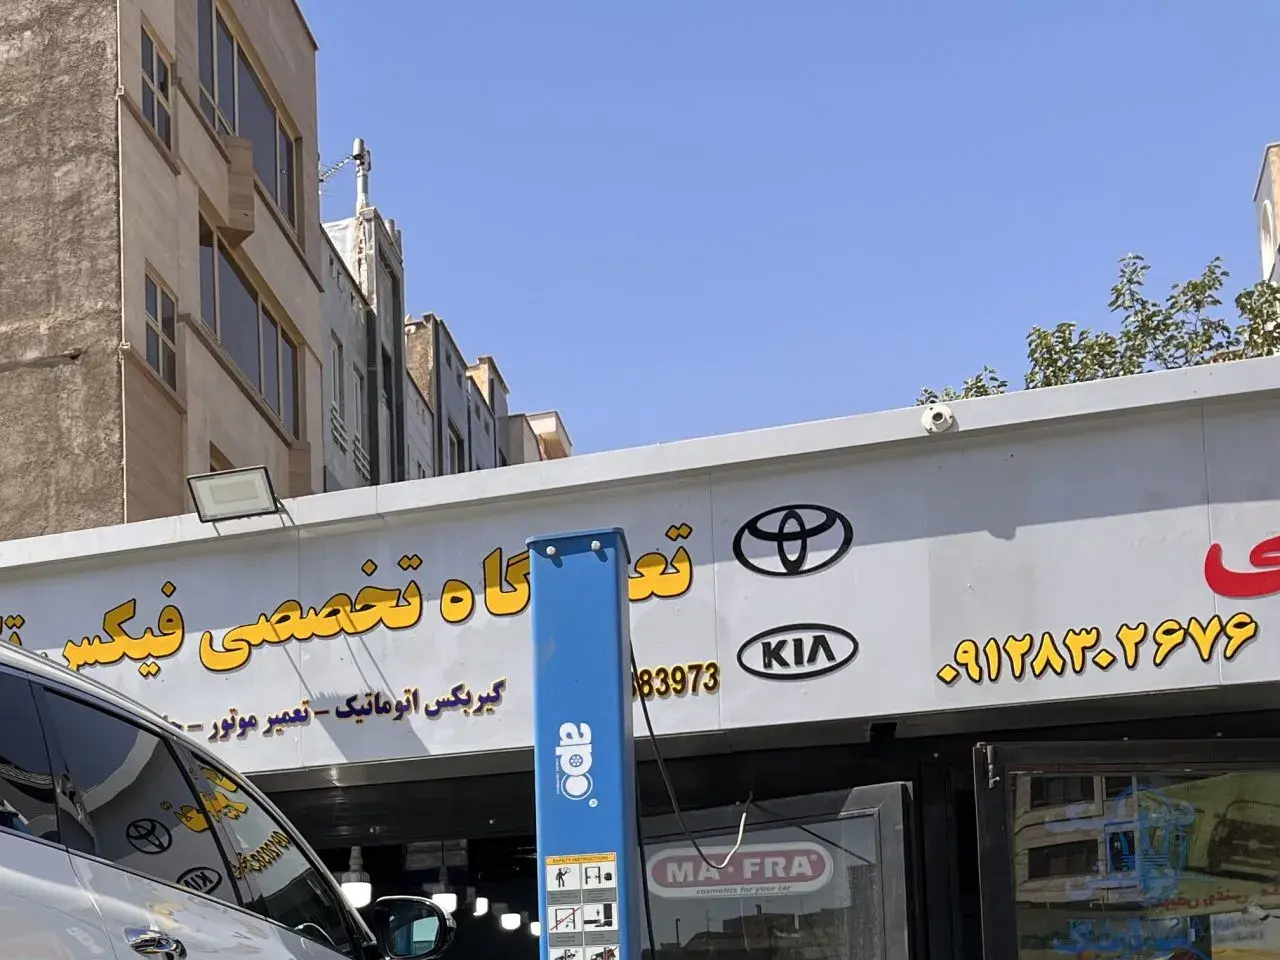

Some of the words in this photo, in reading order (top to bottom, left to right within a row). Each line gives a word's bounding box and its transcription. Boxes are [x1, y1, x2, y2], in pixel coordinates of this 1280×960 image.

[199, 554, 423, 671] تخصصی
[762, 634, 837, 670] KIA
[937, 612, 1258, 685] ۰۹۱۲۸۳۰۲۶۷۶
[334, 688, 420, 724] اتوماتیک
[424, 678, 506, 719] گیربکس
[207, 708, 258, 741] موتور
[261, 699, 311, 737] تعمیر
[696, 886, 738, 895] cosmetics
[755, 886, 776, 894] your
